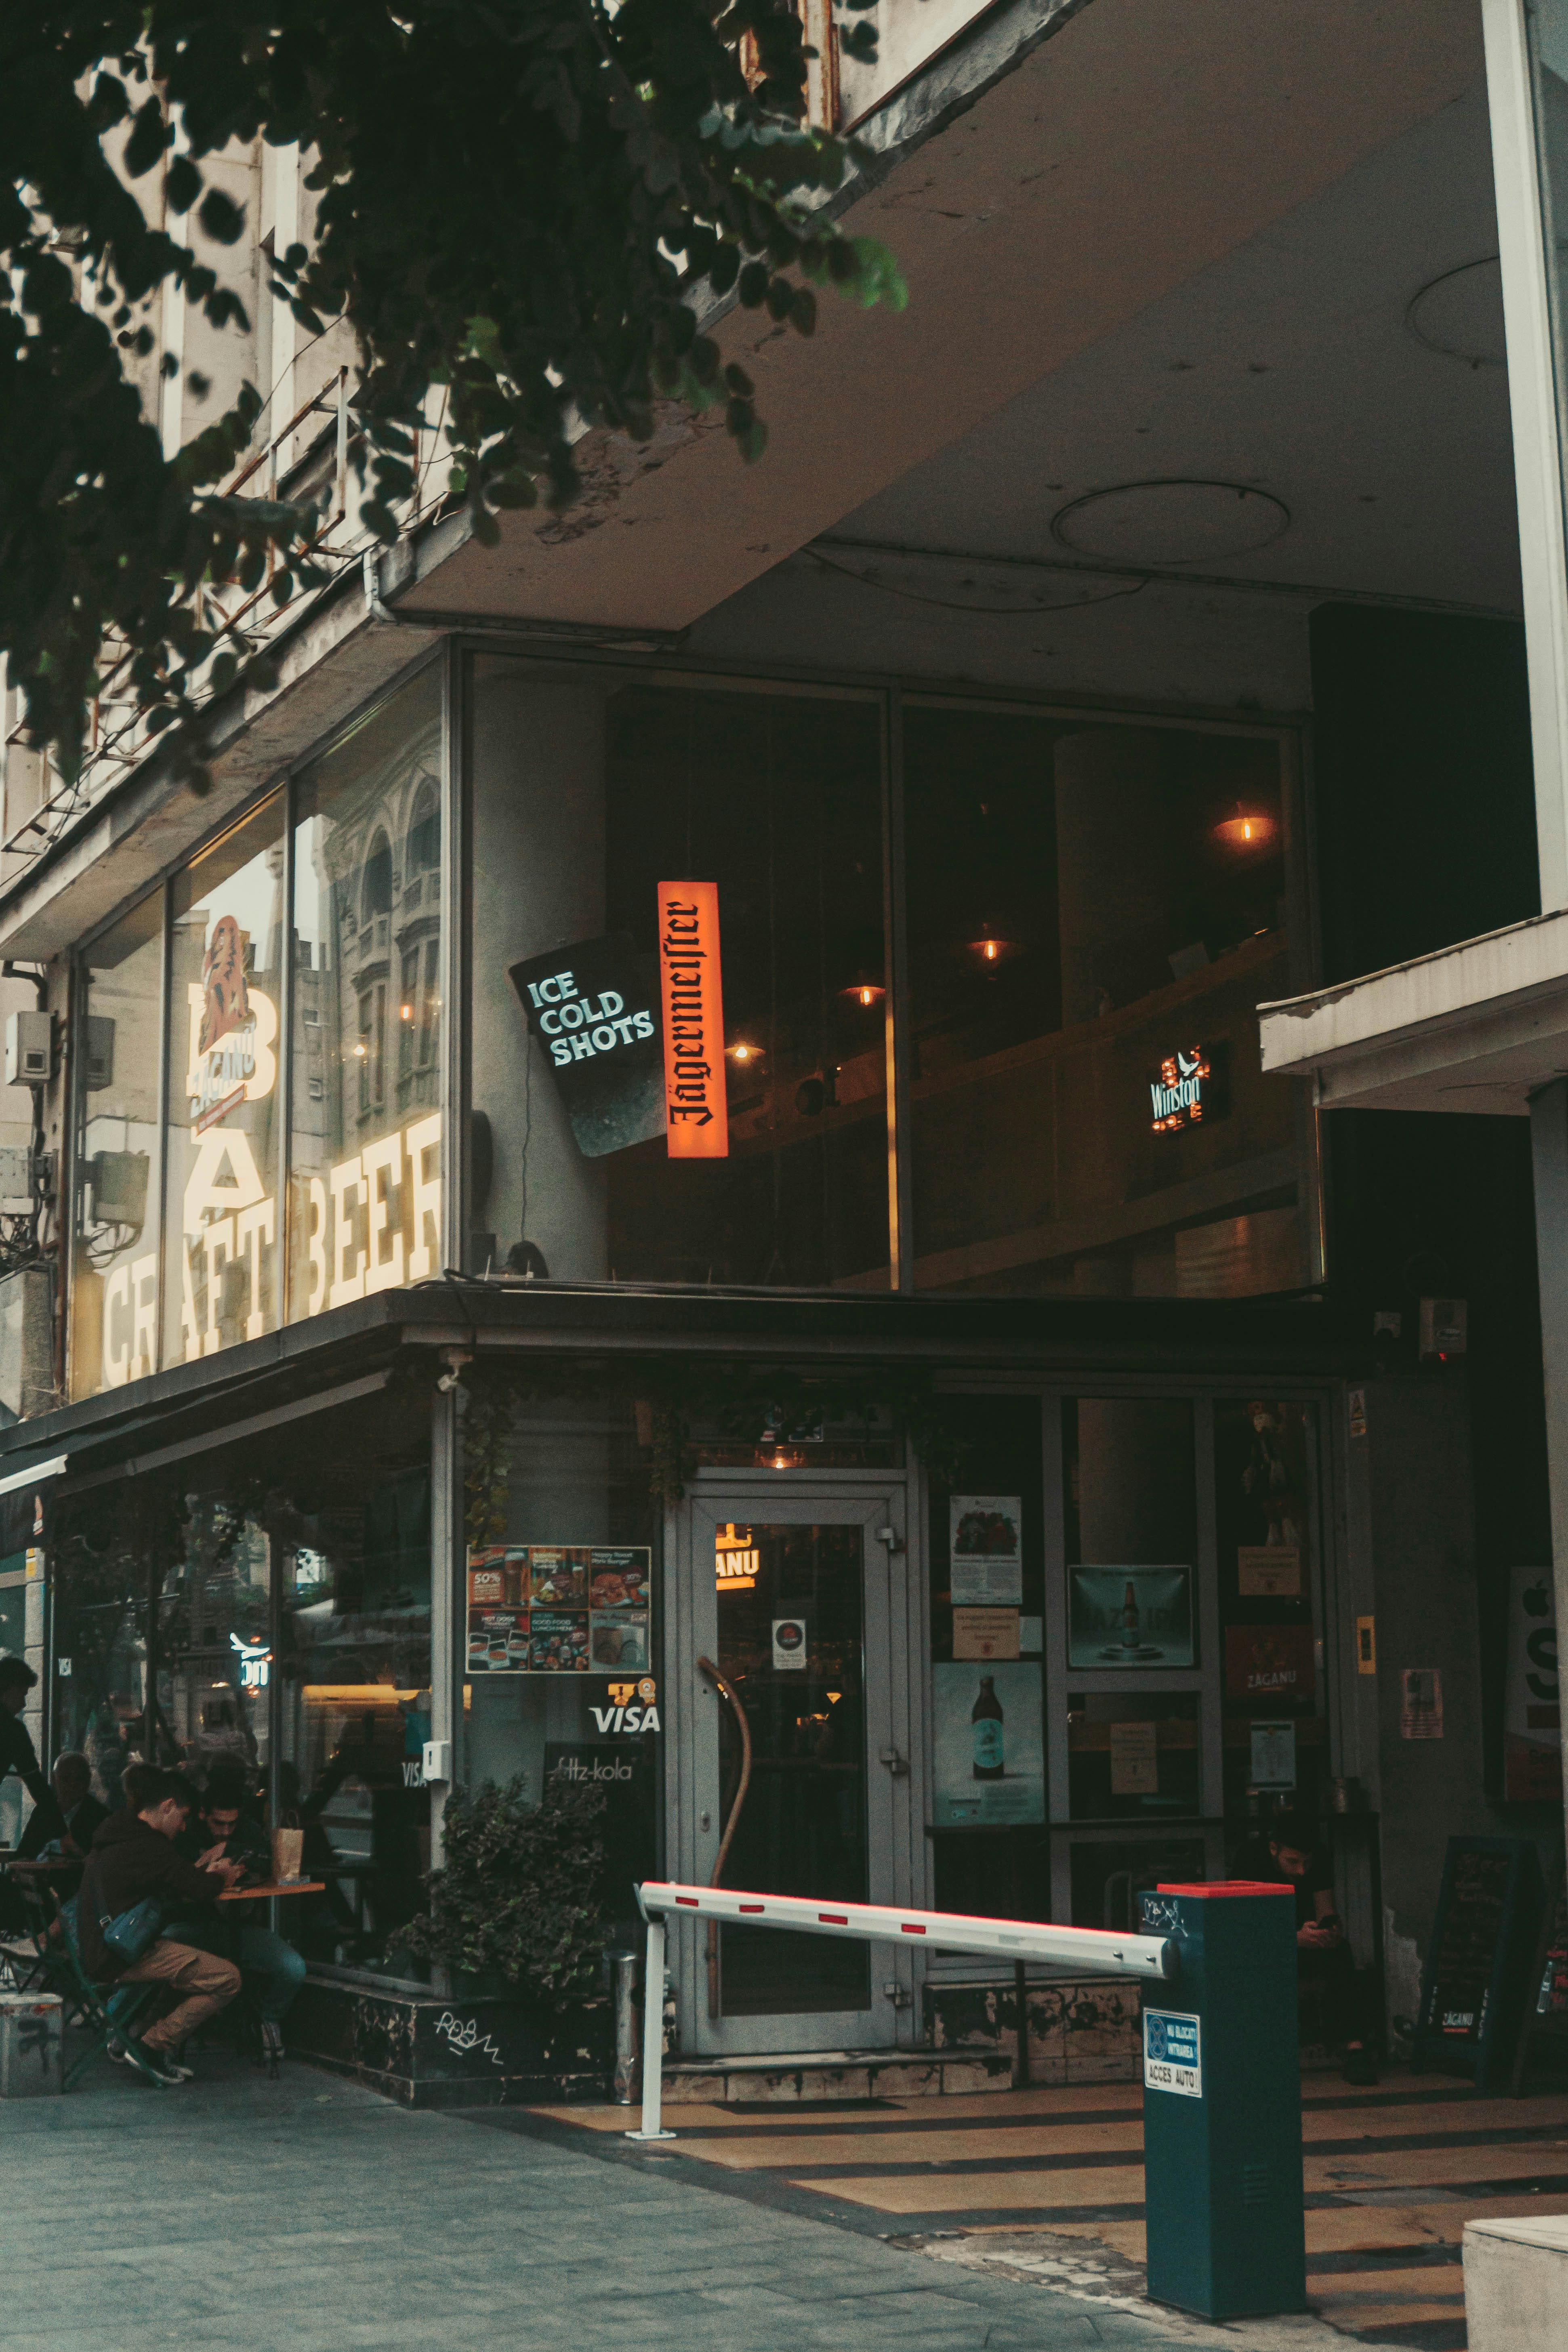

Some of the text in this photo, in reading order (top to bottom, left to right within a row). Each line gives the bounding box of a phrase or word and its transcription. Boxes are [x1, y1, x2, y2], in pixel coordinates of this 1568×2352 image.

[527, 971, 578, 1008] ICE
[540, 991, 624, 1034] COLD
[550, 1010, 655, 1066] SHOTS
[1150, 1076, 1200, 1120] Winston
[474, 1572, 501, 1584] 50%
[588, 1706, 660, 1733] VISA
[1149, 2064, 1171, 2083] ACCES
